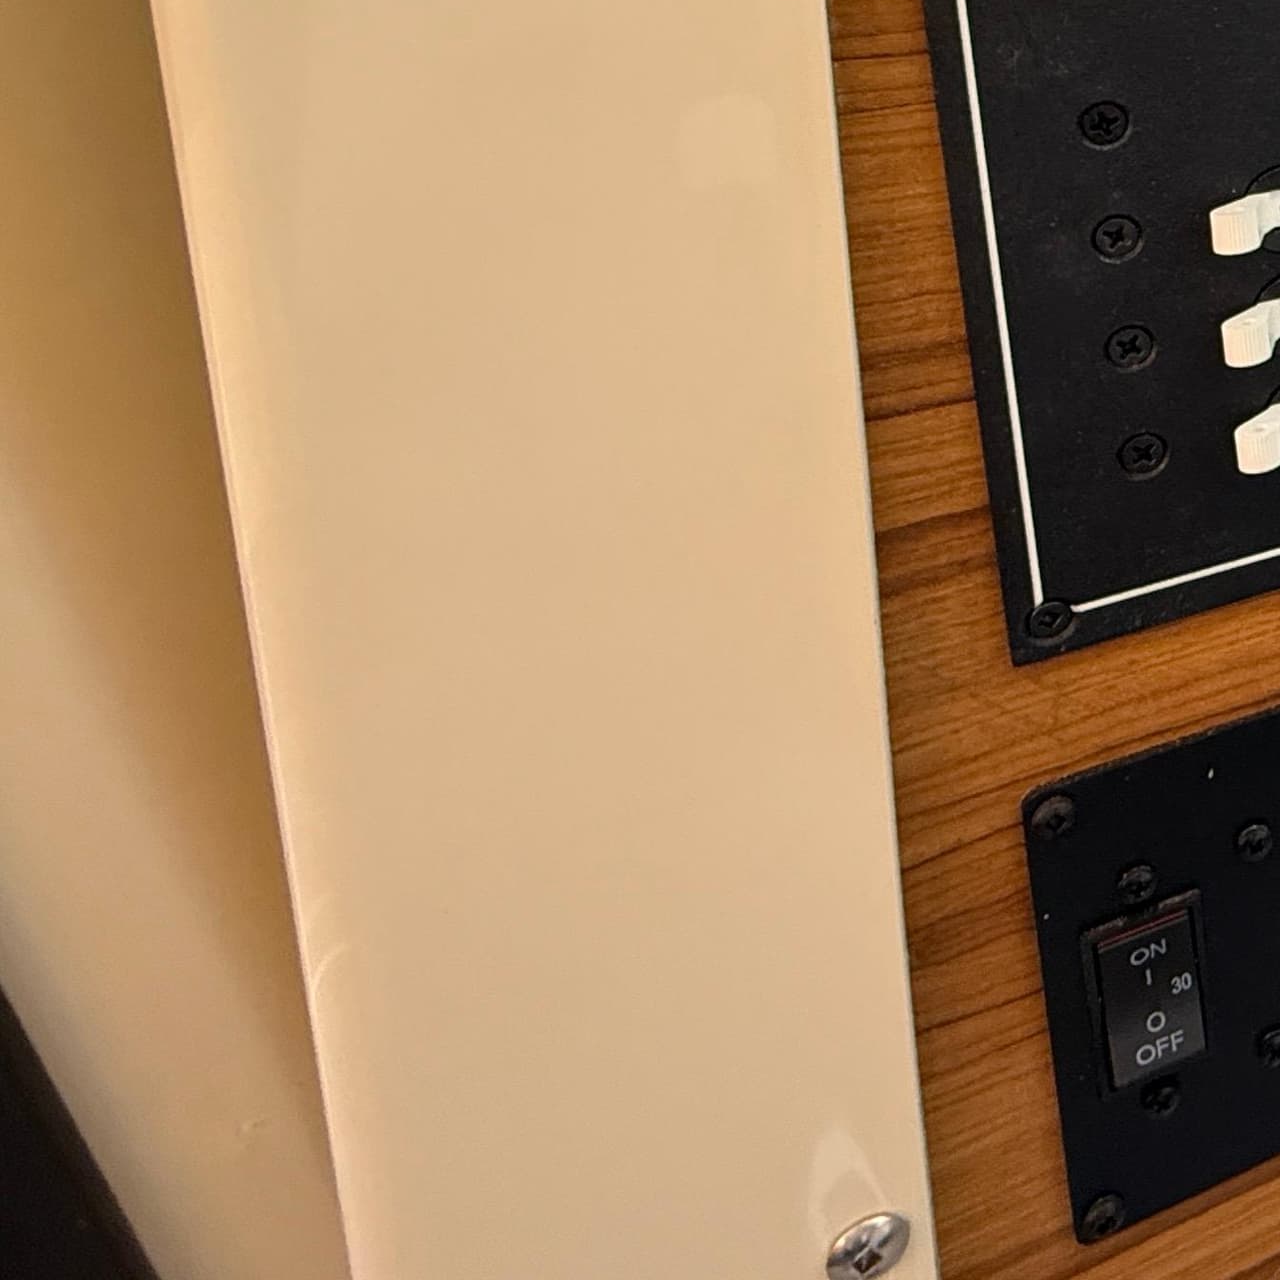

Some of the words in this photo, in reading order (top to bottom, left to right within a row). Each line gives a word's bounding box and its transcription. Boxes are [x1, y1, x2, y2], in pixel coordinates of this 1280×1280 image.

[1130, 937, 1167, 967] ON
[1170, 971, 1192, 995] 30
[1135, 1029, 1185, 1066] OFF
